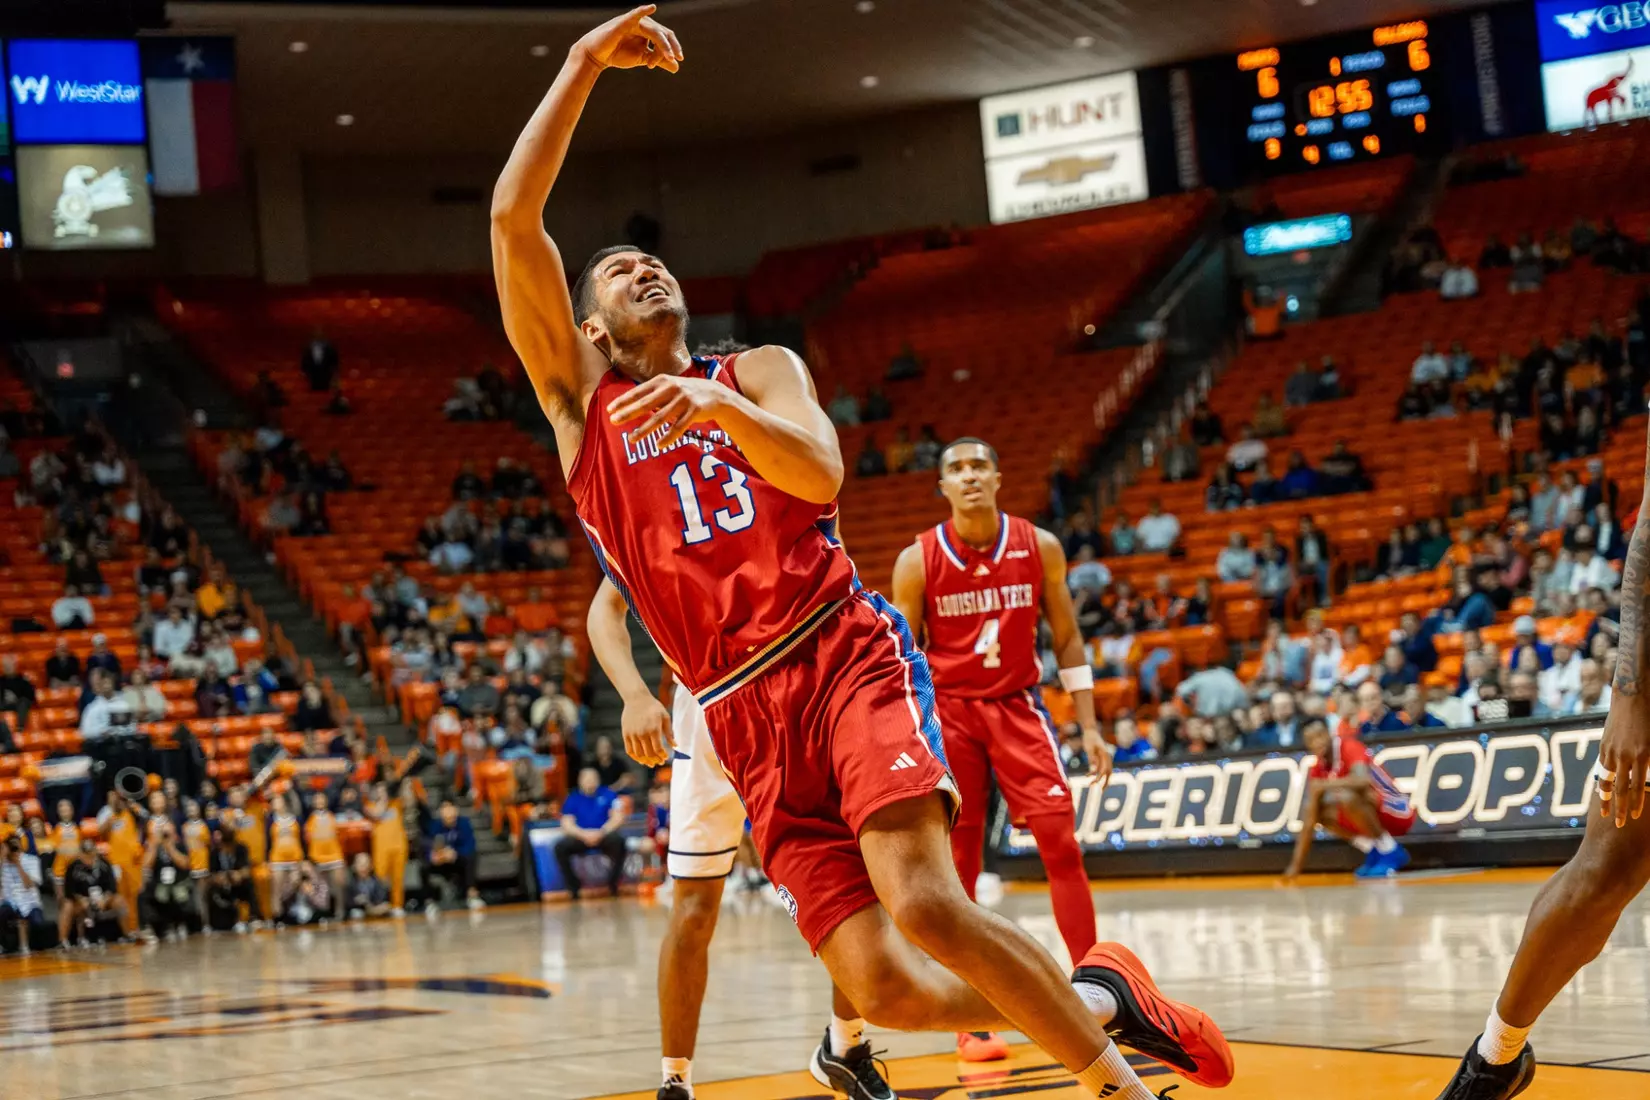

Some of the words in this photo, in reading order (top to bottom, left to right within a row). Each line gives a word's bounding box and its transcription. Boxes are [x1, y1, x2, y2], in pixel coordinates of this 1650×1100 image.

[55, 79, 142, 104] WestStar
[1028, 91, 1124, 132] HUNT
[669, 453, 756, 547] 13
[935, 587, 1002, 618] LOUISIANA
[1000, 583, 1034, 610] TECH
[973, 617, 1002, 669] 4
